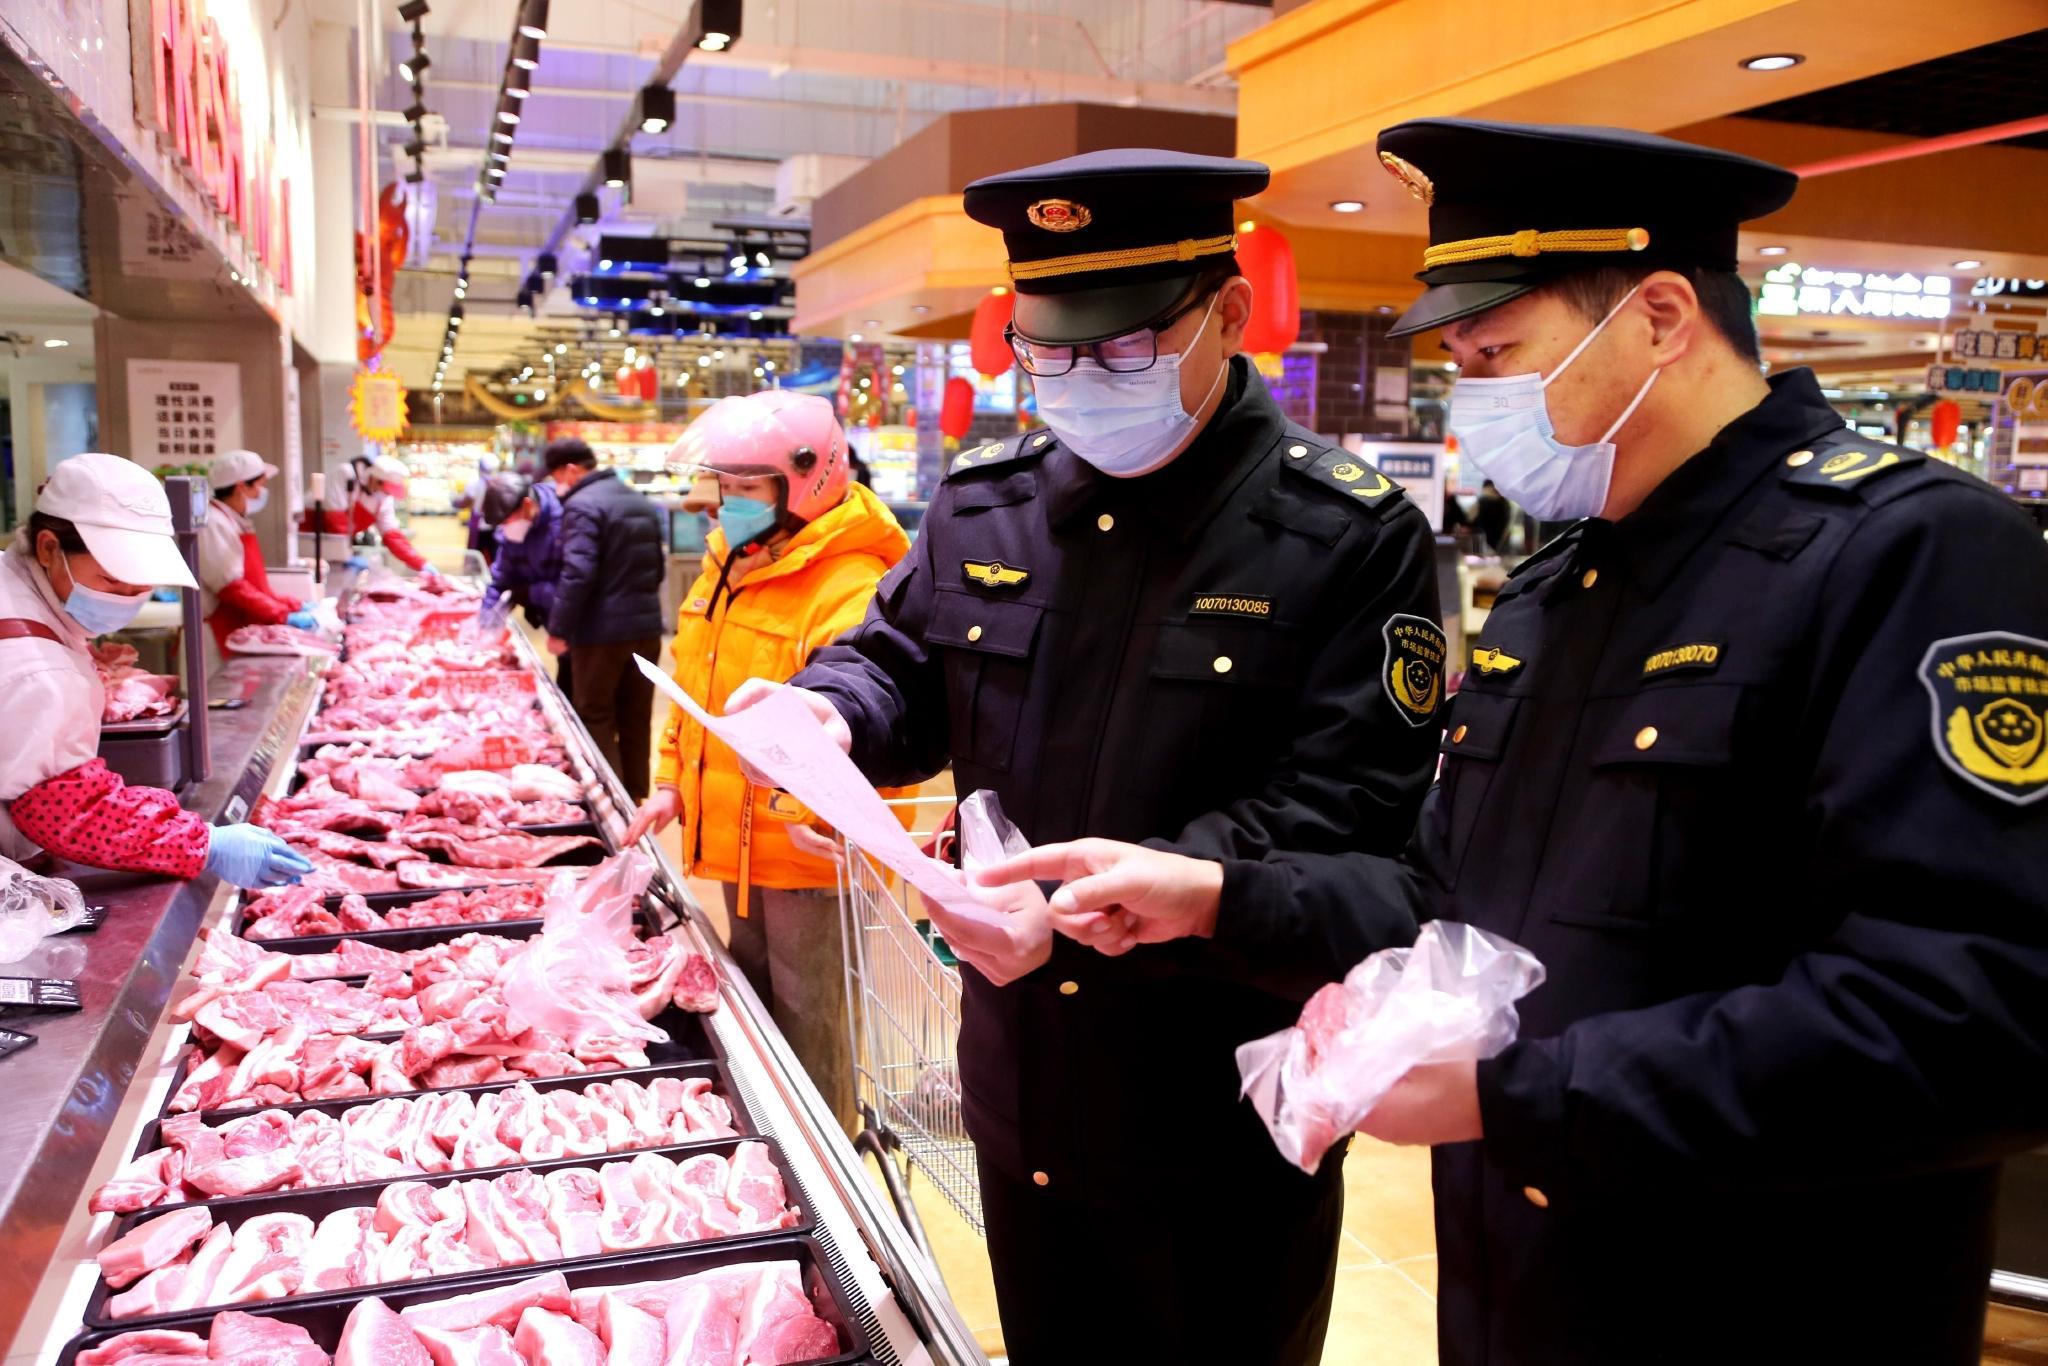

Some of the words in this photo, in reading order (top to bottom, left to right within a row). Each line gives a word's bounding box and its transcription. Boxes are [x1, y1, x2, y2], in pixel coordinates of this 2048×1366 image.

[156, 394, 214, 407] 理性消费
[1195, 598, 1270, 614] 10070130085
[1394, 625, 1446, 656] 中华人民共和国
[1936, 649, 2048, 678] 中华人民共和
